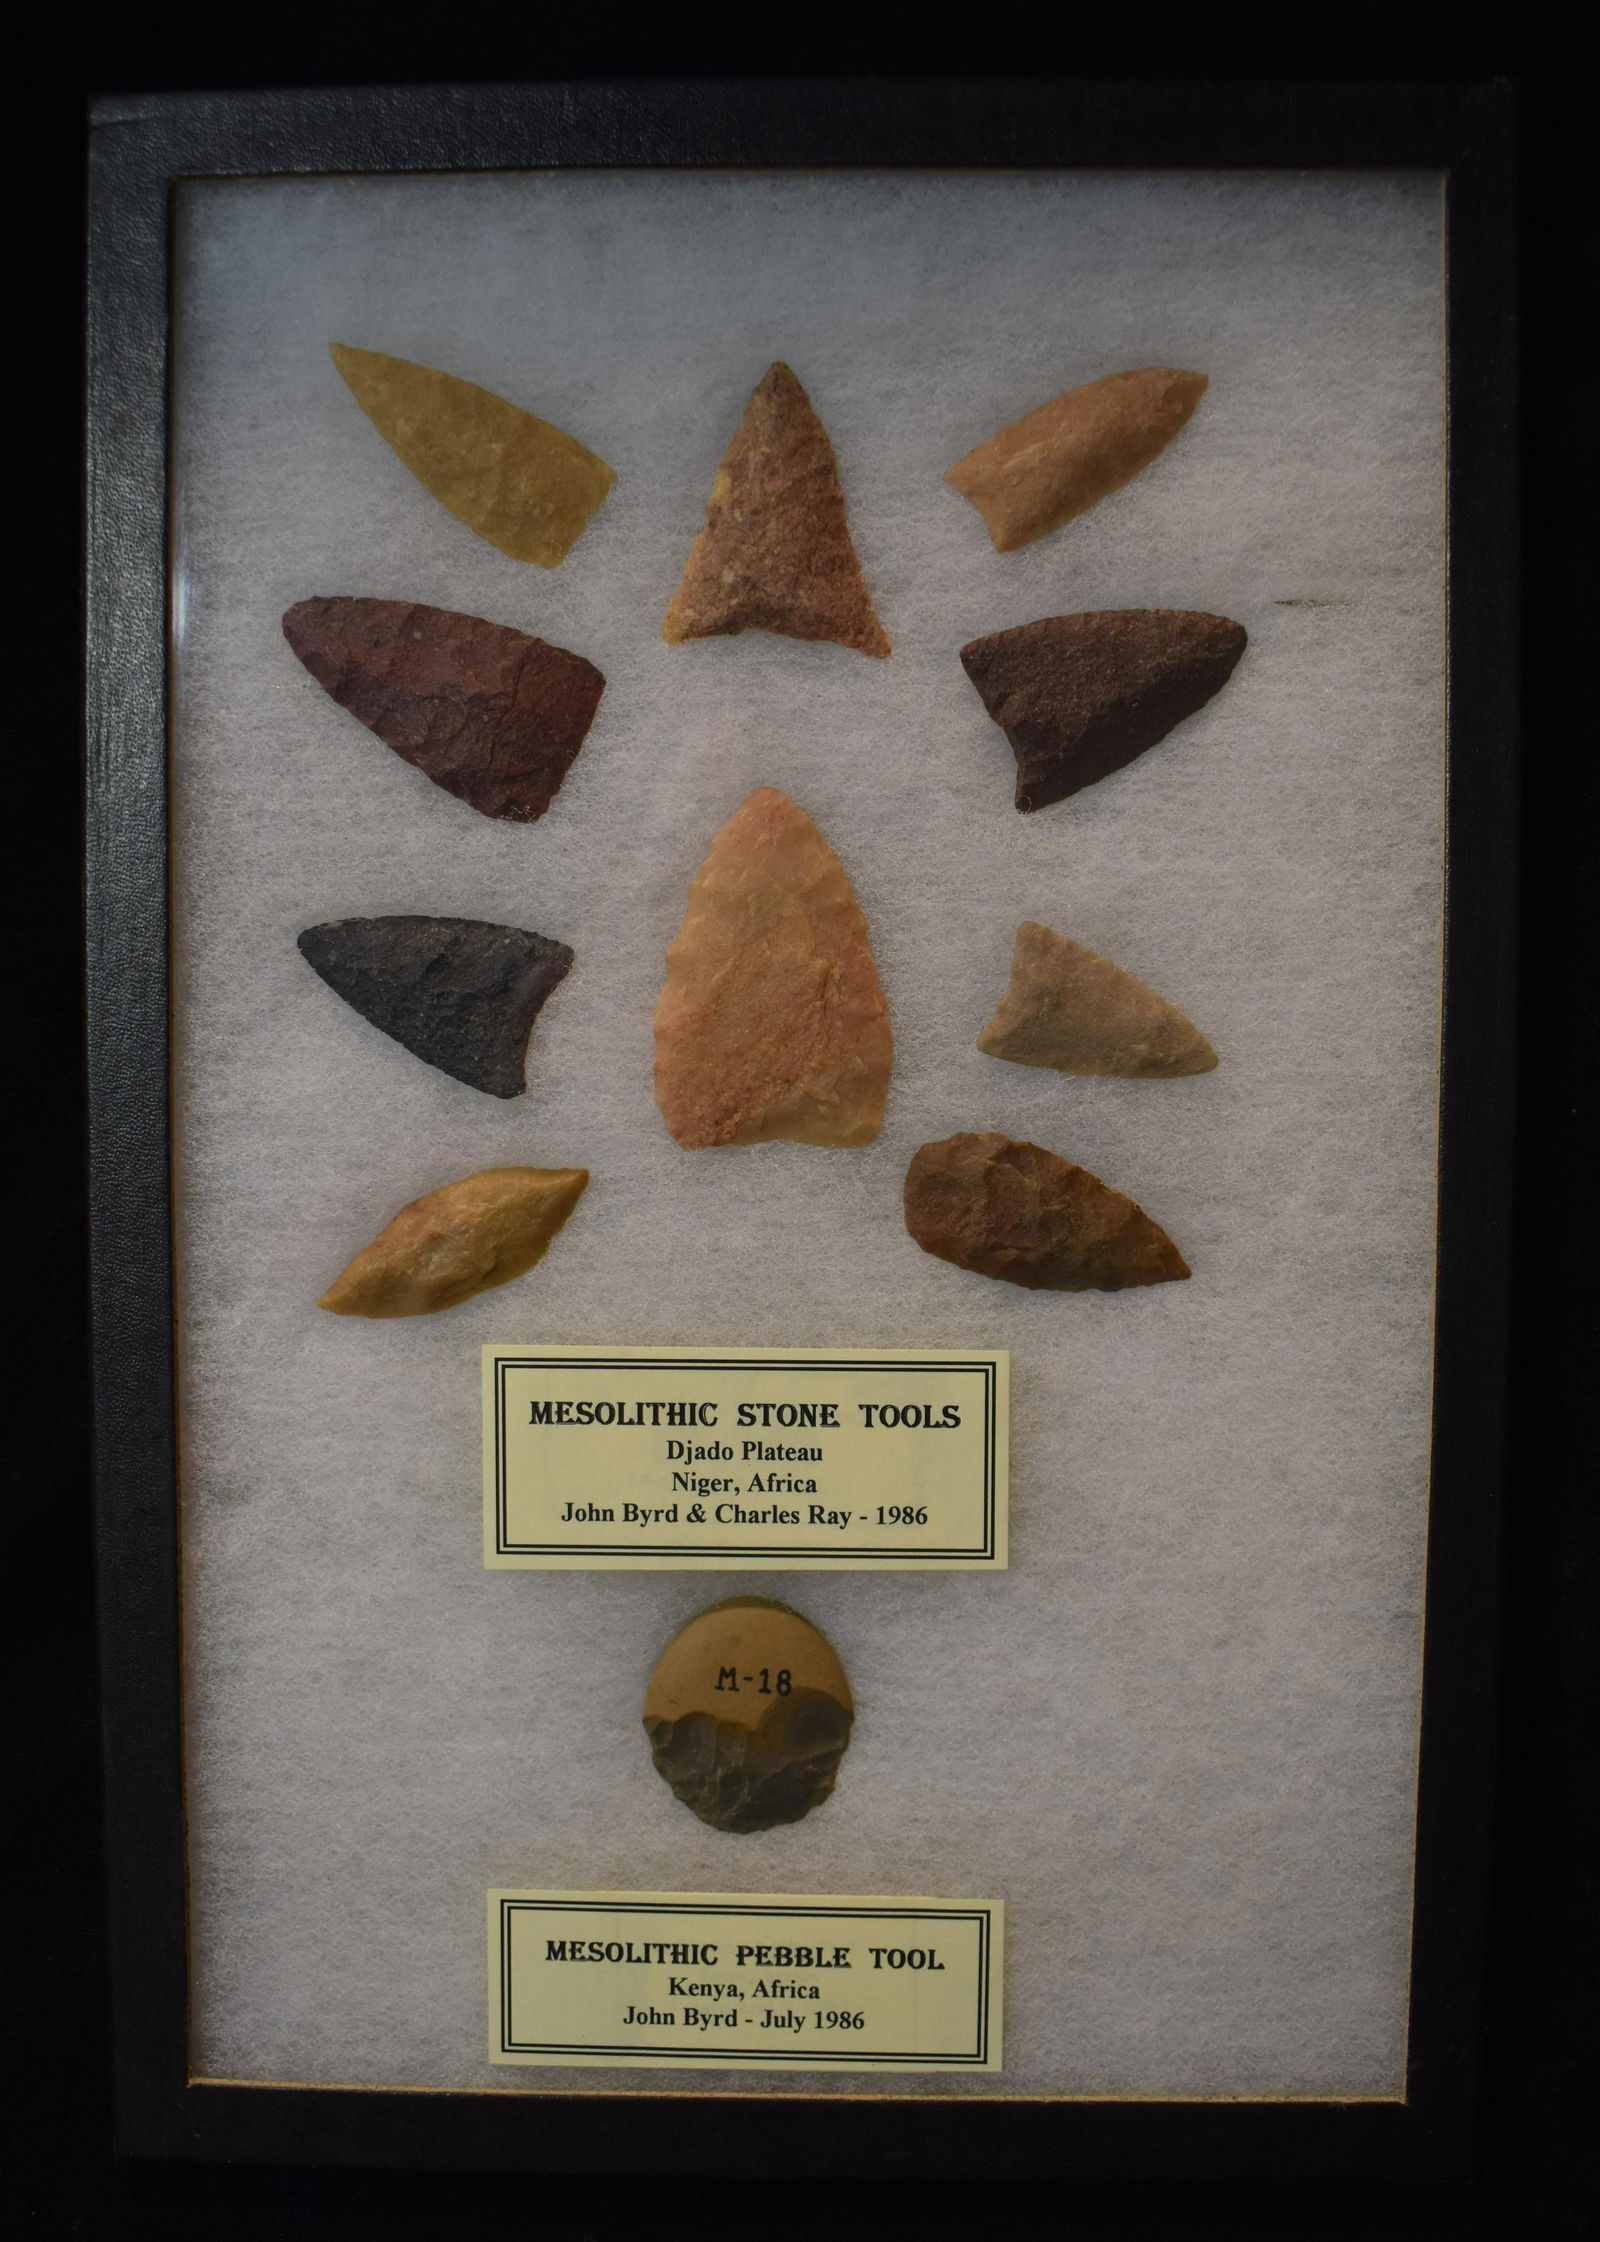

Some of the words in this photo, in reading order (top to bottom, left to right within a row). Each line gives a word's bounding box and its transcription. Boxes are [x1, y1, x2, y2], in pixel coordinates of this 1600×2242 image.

[529, 1401, 717, 1426] MESOLITHIC
[737, 1403, 840, 1427] STONE
[858, 1404, 961, 1428] TOOLS
[667, 1440, 733, 1463] Djado
[742, 1441, 822, 1461] Plateau
[672, 1472, 740, 1495] Niger,
[747, 1473, 817, 1493] Africa
[562, 1503, 614, 1521] John
[623, 1503, 678, 1527] Byrd
[687, 1504, 706, 1523] &
[715, 1504, 799, 1524] Charles
[808, 1505, 852, 1529] Ray
[877, 1506, 927, 1525] 1986
[715, 1667, 792, 1695] M-18
[546, 1940, 718, 1965] MESOLITHIC
[736, 1945, 852, 1968] PEBBLE
[869, 1948, 945, 1970] TOOL
[669, 1977, 744, 2001] Kenya,
[752, 1979, 820, 1999] Africa
[623, 2006, 675, 2025] John
[683, 2008, 737, 2031] Byrd
[760, 2009, 806, 2033] July
[815, 2011, 864, 2029] 1986
